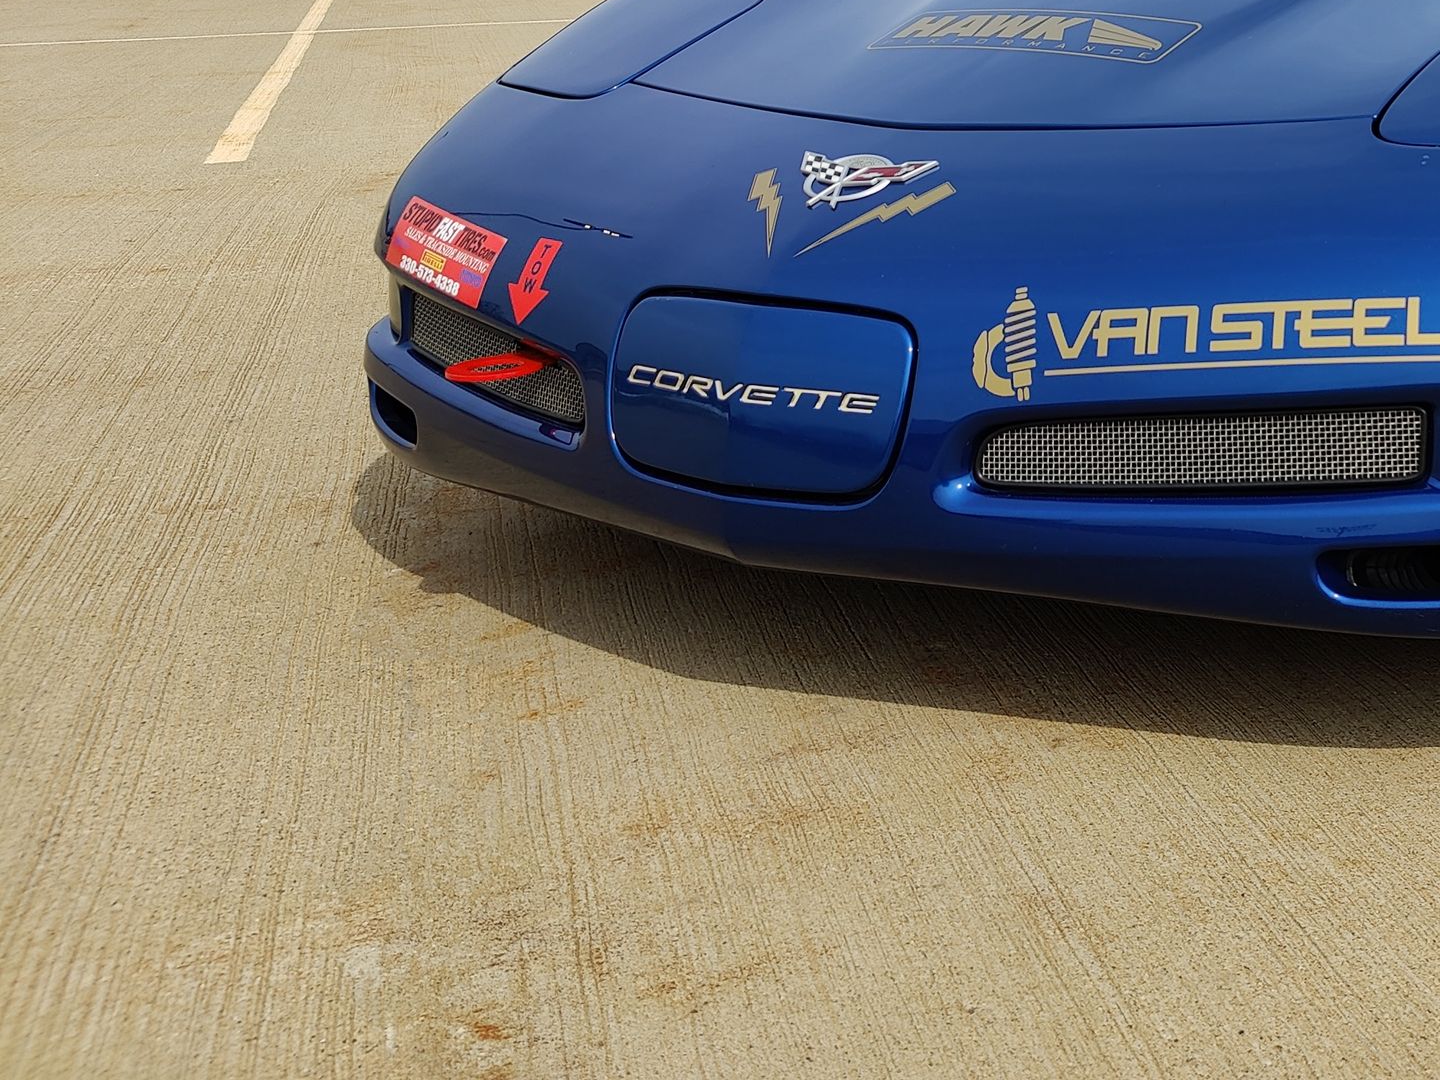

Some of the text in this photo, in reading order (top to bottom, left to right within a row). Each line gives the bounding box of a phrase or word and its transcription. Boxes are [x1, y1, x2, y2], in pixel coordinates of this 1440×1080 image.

[891, 14, 1092, 41] HAWK
[405, 226, 423, 241] SALES
[454, 250, 489, 273] MOUNTING
[1046, 304, 1200, 361] VAN
[626, 364, 881, 415] CORVETTE
